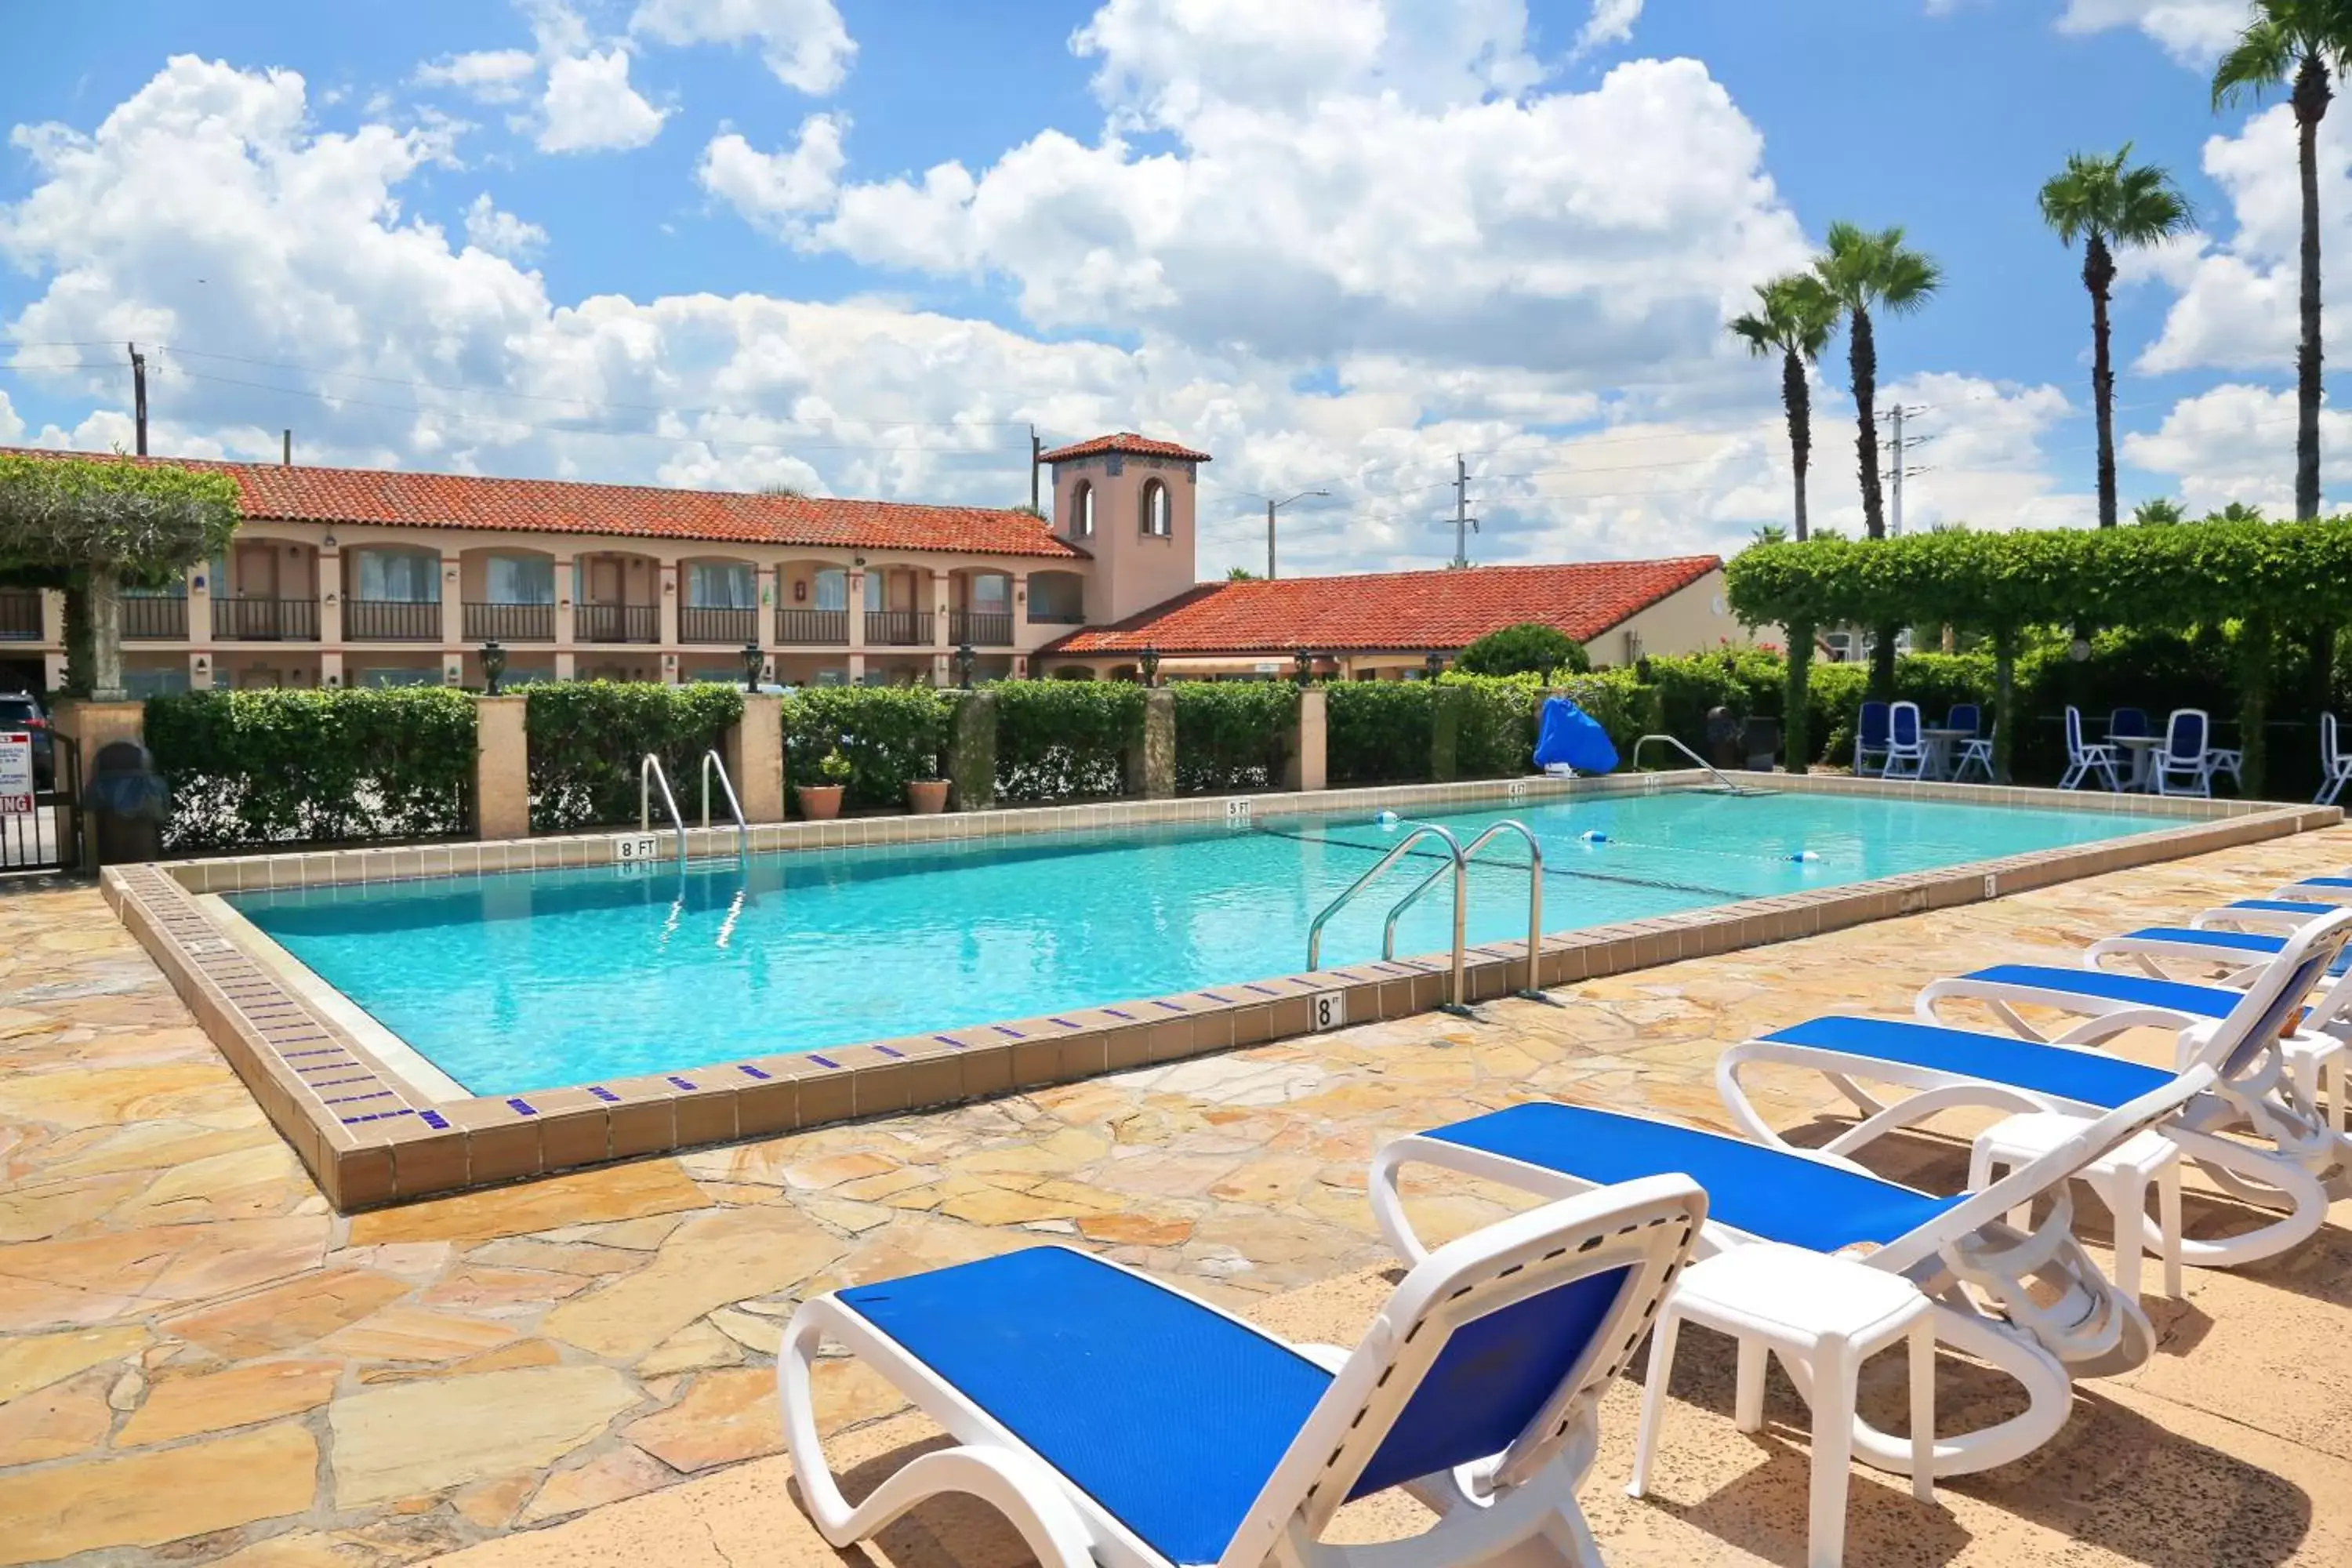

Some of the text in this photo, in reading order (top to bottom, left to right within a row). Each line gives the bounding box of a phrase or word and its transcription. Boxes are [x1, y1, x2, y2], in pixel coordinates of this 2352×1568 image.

[1230, 802, 1249, 815] 5 FT
[622, 840, 655, 856] 8 FT
[1319, 999, 1330, 1025] 8
